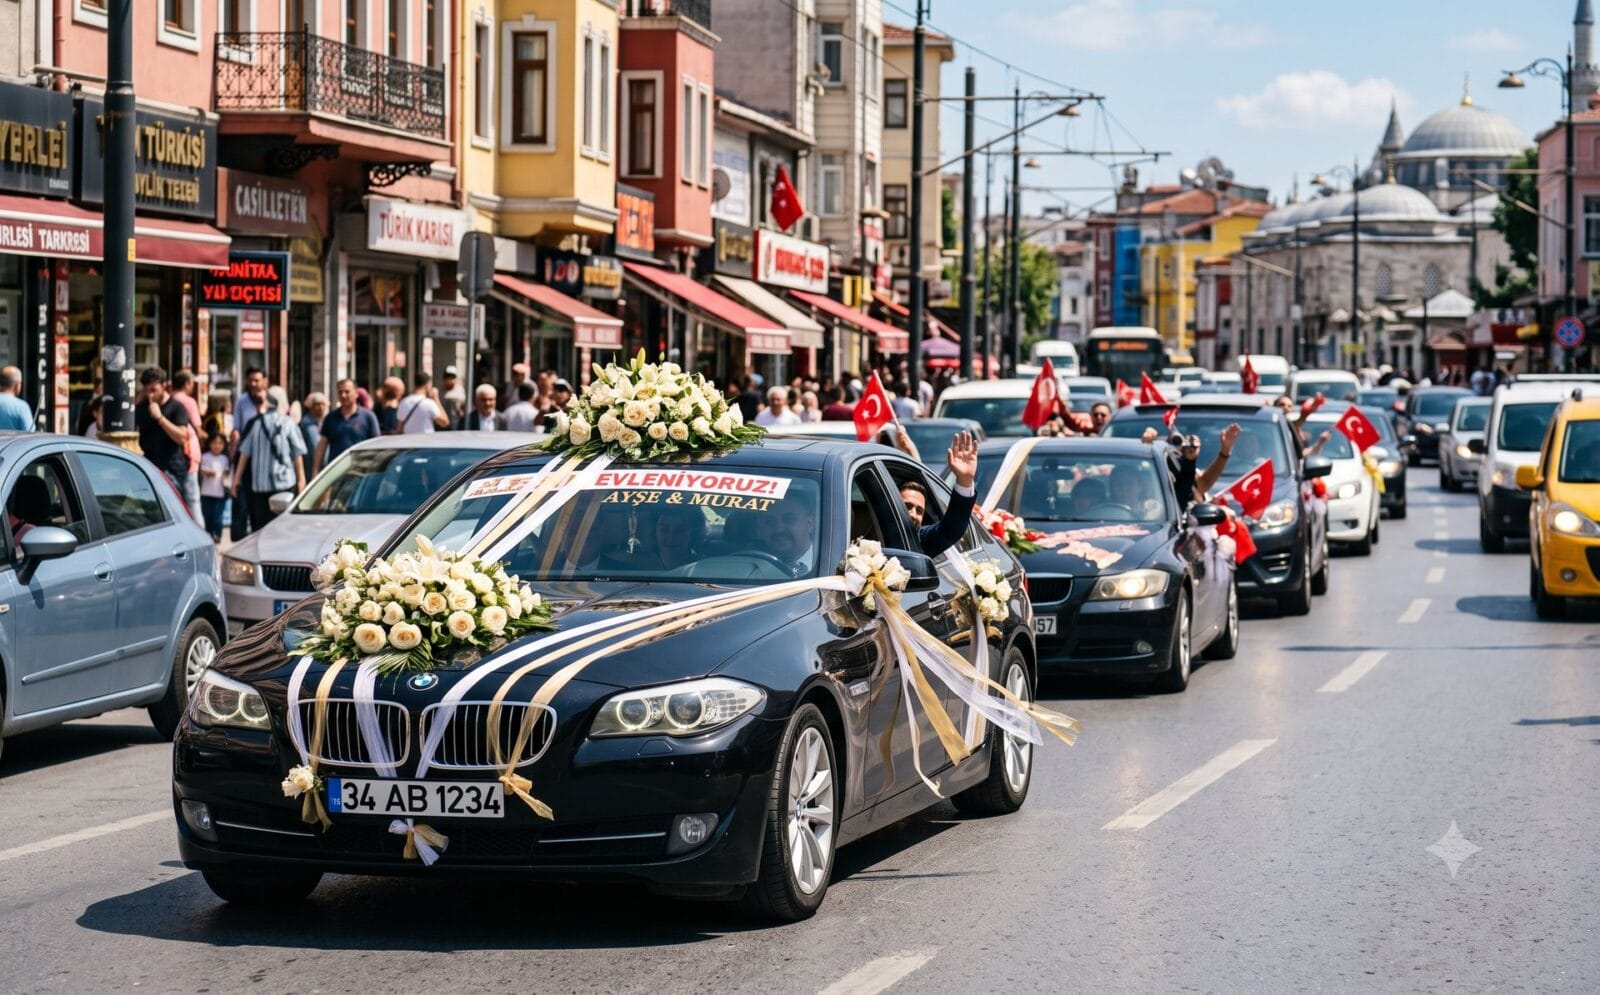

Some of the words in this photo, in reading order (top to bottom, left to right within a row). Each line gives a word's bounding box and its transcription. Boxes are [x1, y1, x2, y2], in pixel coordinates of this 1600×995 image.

[0, 223, 34, 249] RLESİ
[594, 471, 778, 494] EVLENİYORUZ!
[601, 491, 662, 506] AYŞE
[665, 491, 684, 505] &
[687, 493, 775, 511] MURAT
[342, 782, 376, 811] 34
[385, 784, 428, 813] AB
[436, 785, 500, 815] 1234
